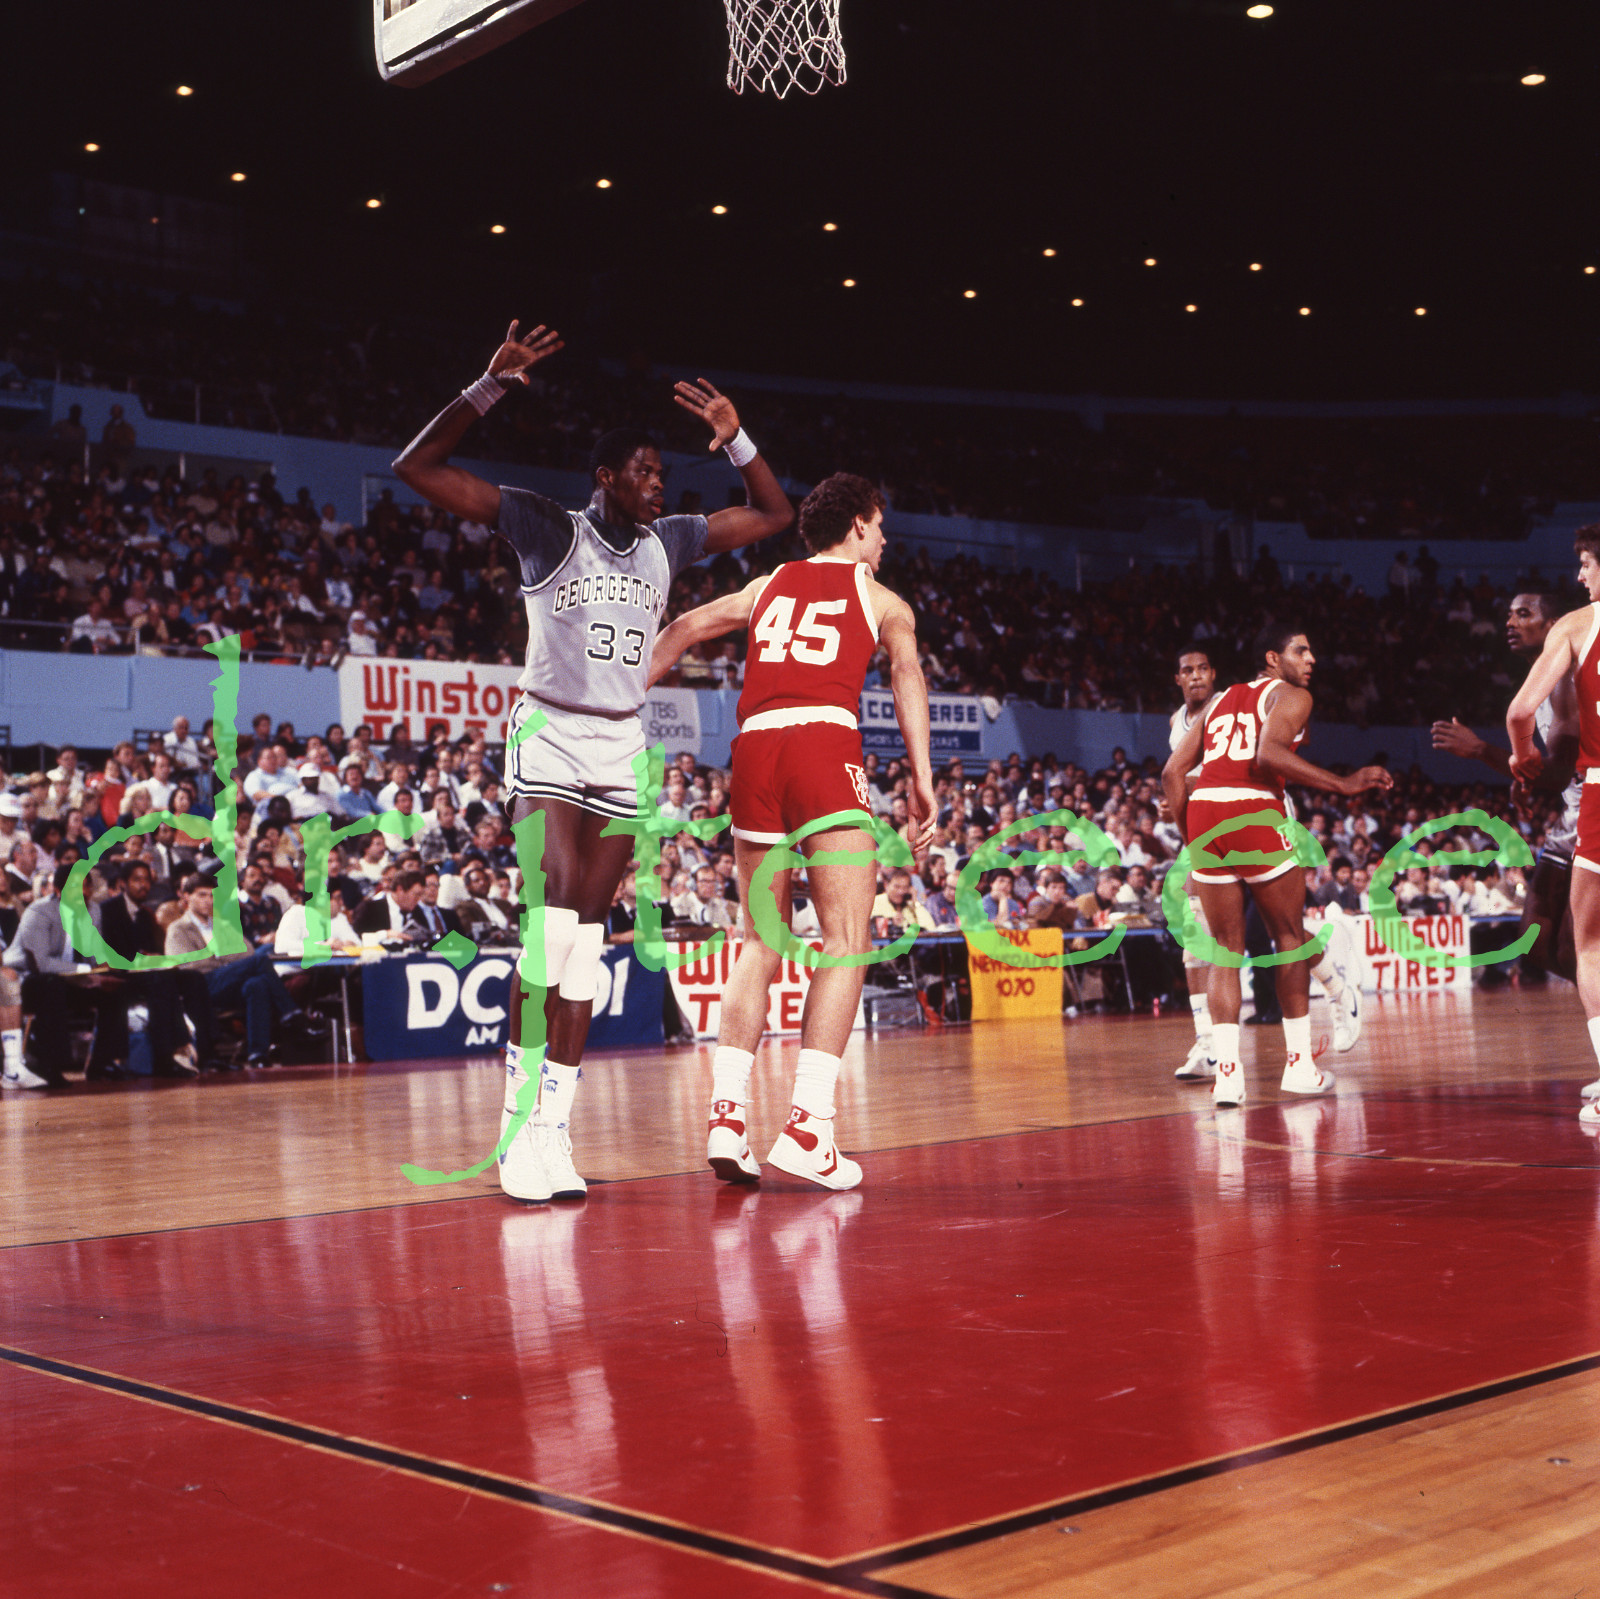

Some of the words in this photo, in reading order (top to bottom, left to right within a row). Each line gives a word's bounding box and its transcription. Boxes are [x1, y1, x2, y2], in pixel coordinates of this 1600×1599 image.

[585, 622, 646, 667] 33
[755, 595, 848, 666] 45
[650, 702, 678, 720] TBS
[867, 700, 977, 723] COERSE
[648, 720, 695, 741] Sports
[1203, 711, 1257, 765] 30
[1372, 953, 1455, 990] TIRES
[996, 977, 1036, 998] 1070
